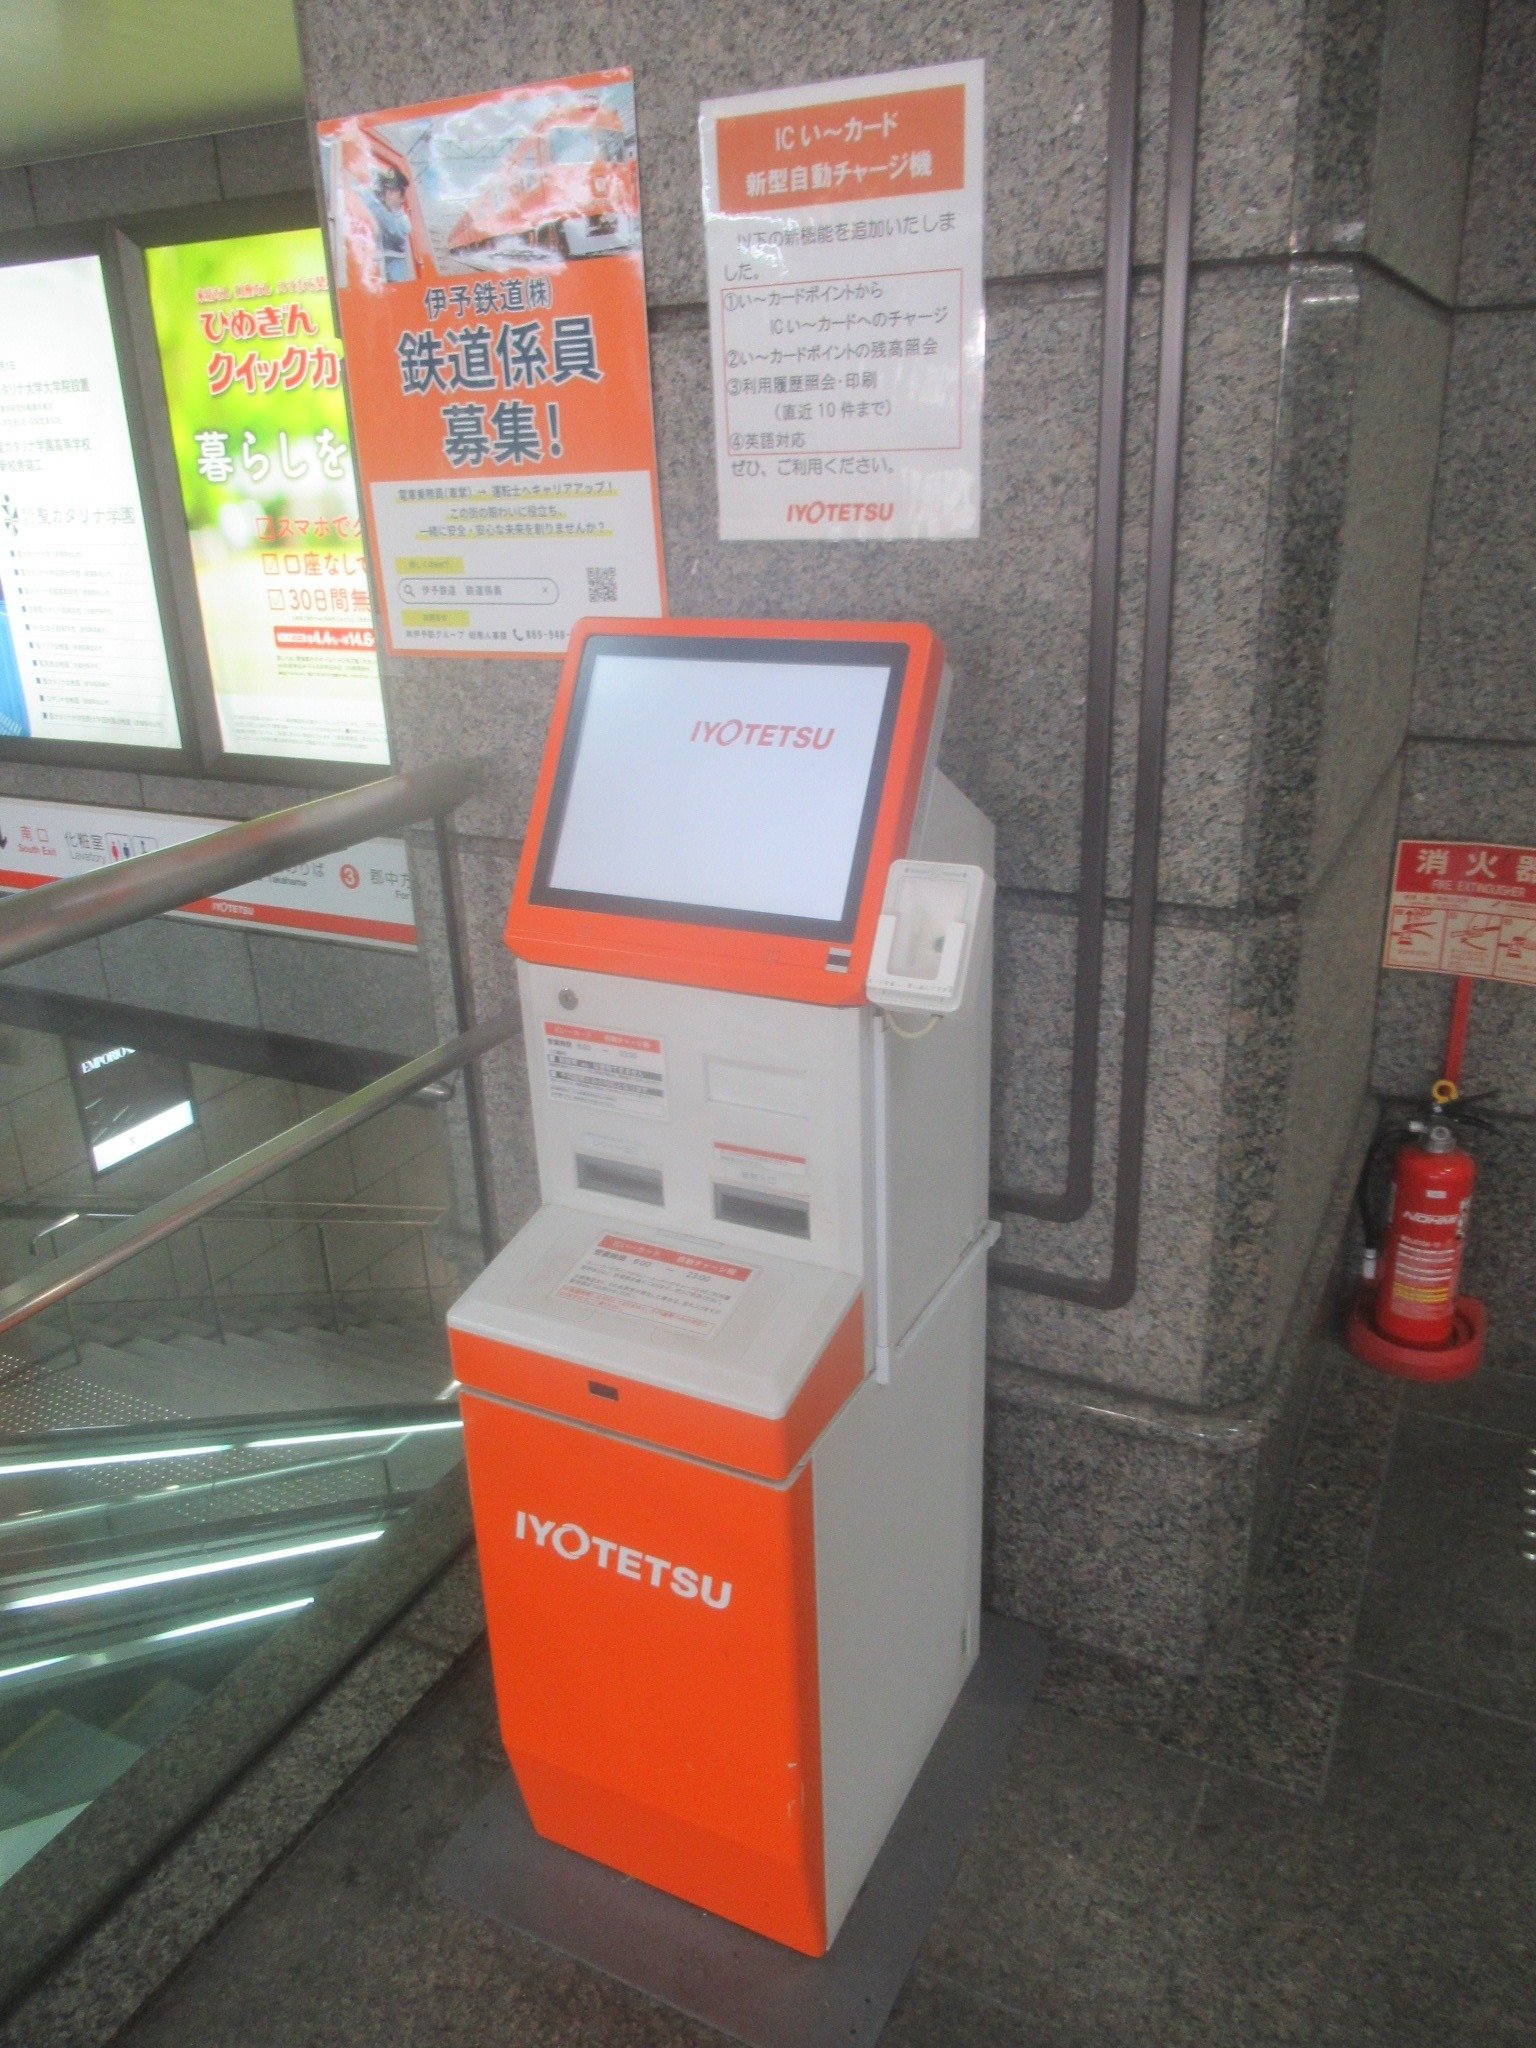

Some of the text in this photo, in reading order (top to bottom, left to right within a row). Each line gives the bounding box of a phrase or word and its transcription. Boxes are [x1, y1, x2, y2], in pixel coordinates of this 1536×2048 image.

[746, 150, 932, 197] 新型自動チャージ機
[724, 263, 760, 282] した。
[200, 303, 318, 343] ひめぎん
[397, 315, 602, 396] 鉄道係員
[194, 427, 347, 483] 暮らしを
[441, 399, 564, 468] 募集!
[787, 501, 894, 525] IYOTETSU
[690, 718, 835, 751] IYOTETSU
[515, 1510, 732, 1610] IYOTETSU
